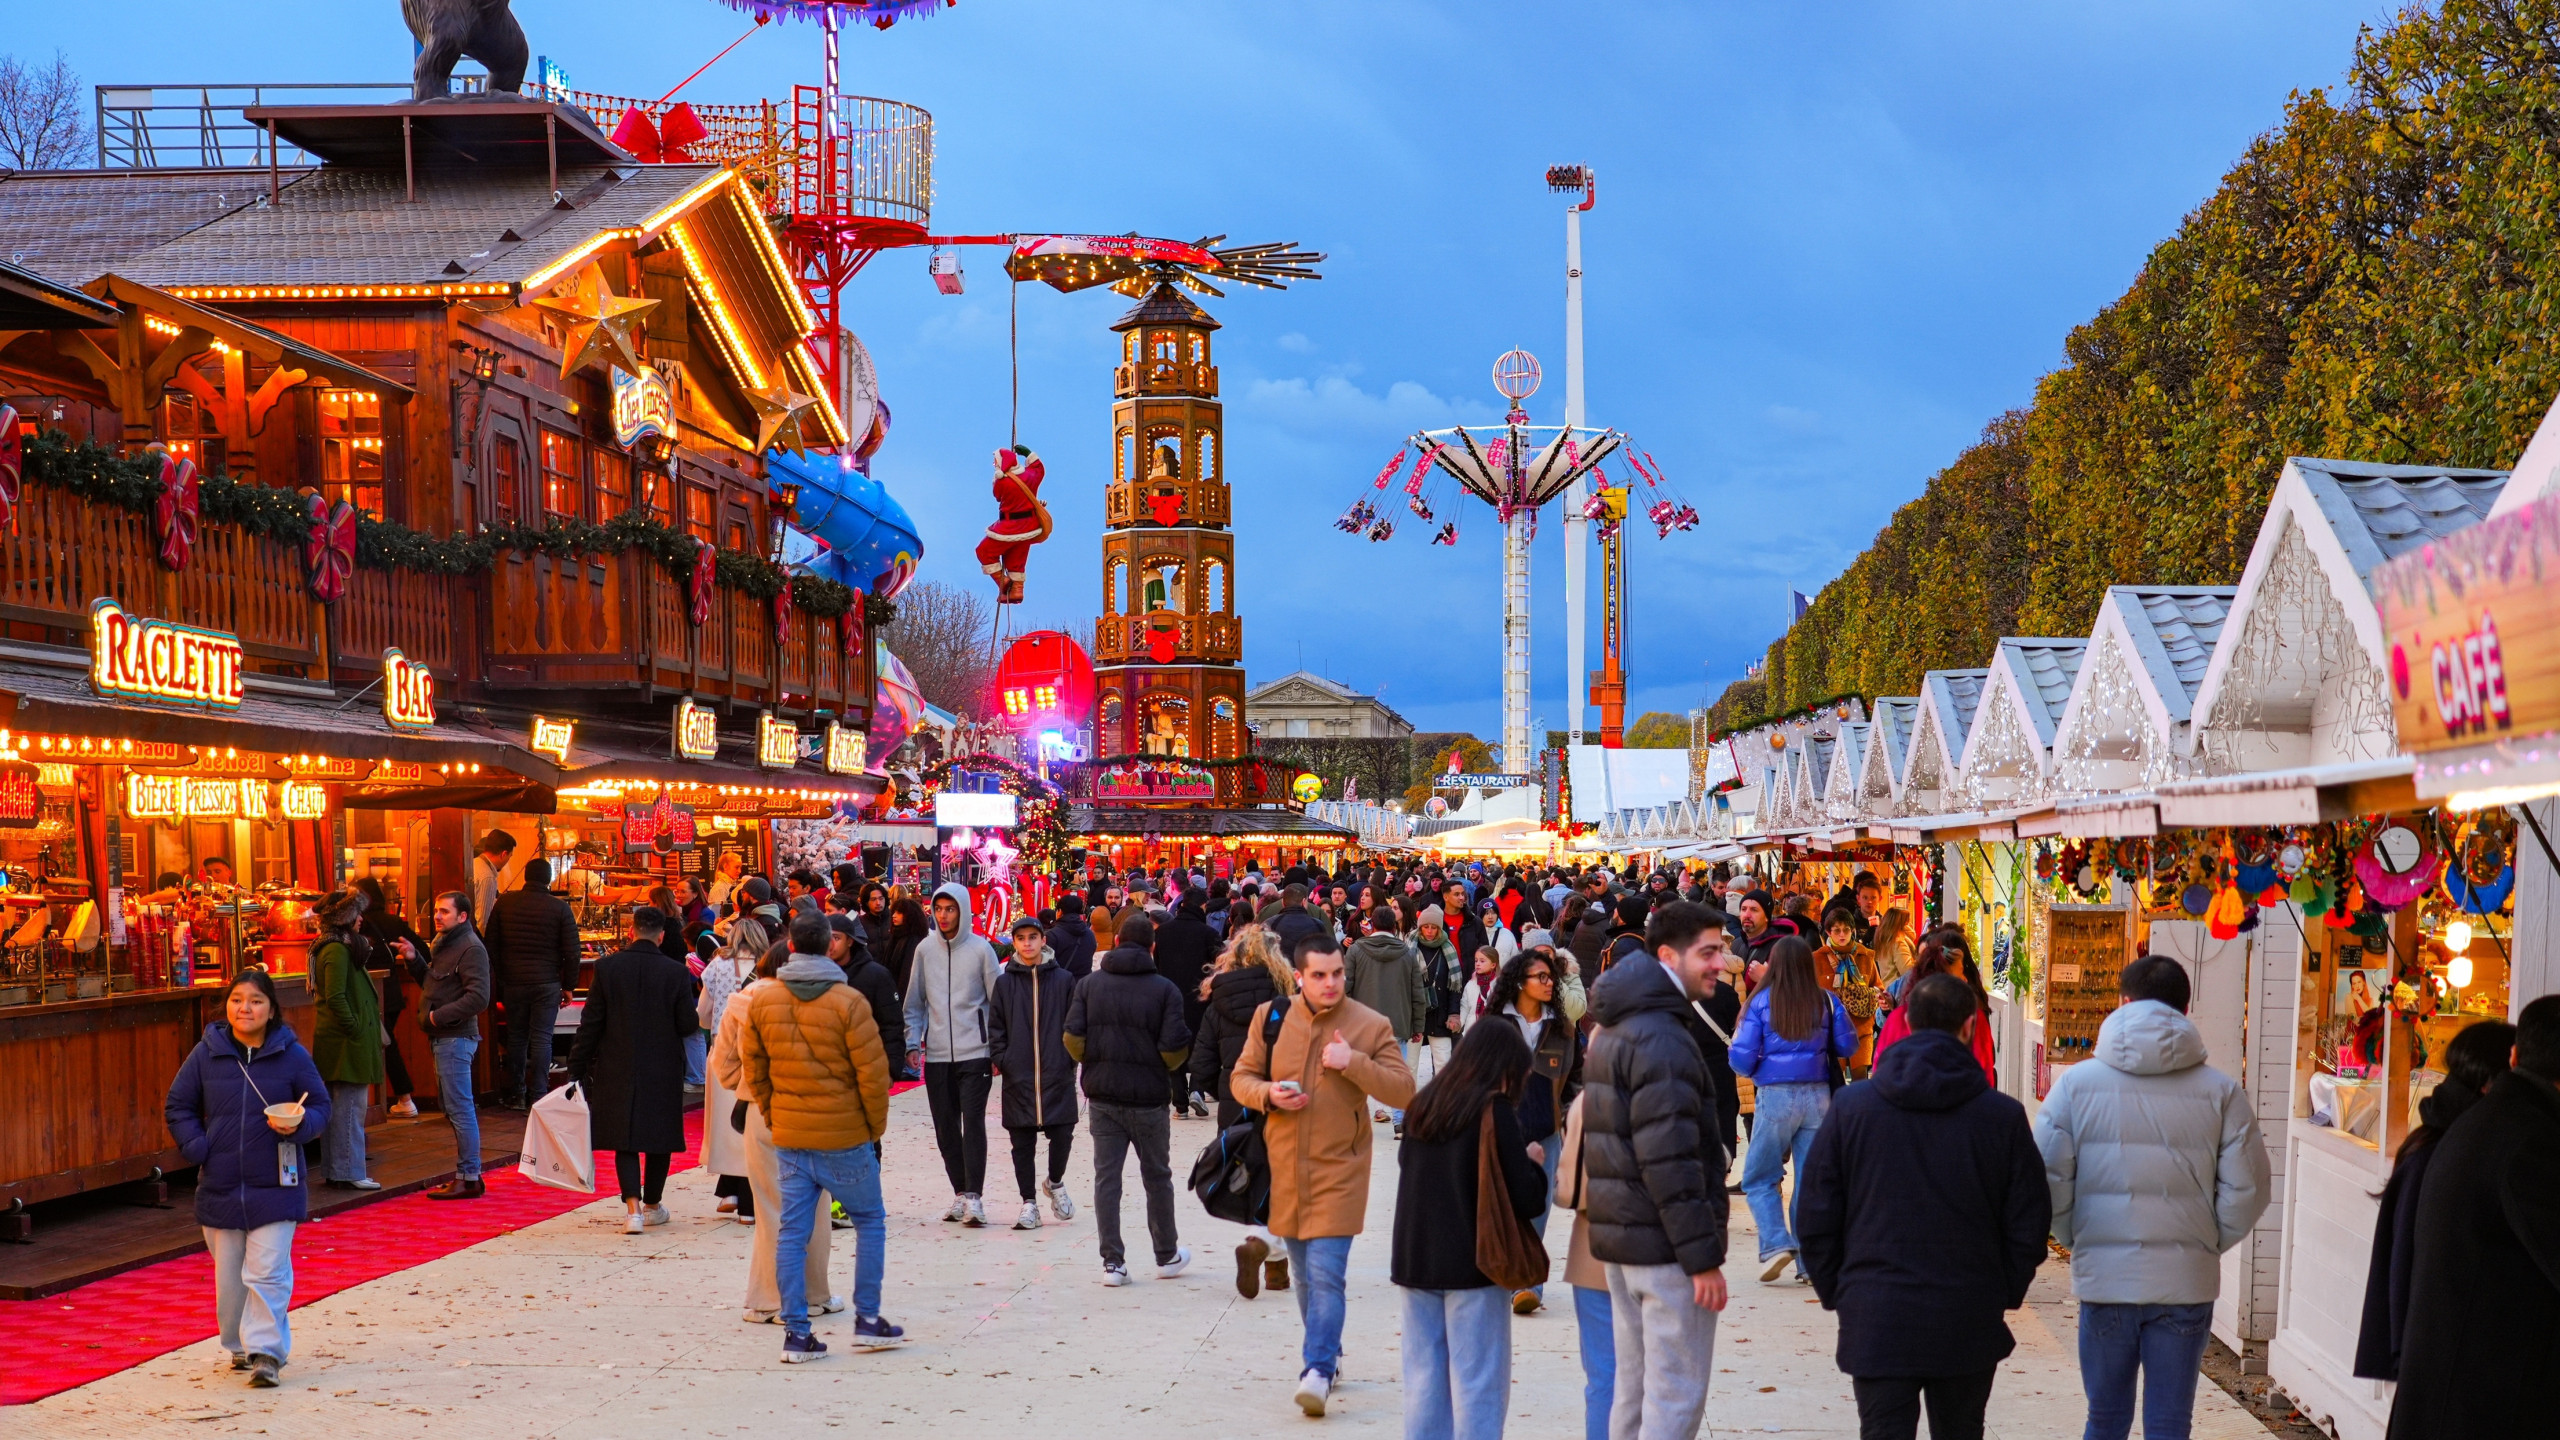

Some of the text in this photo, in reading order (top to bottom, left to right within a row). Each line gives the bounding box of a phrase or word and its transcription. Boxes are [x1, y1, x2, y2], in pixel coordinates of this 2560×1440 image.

[106, 613, 245, 698] RACLETTE
[2431, 610, 2510, 734] CAFÉ
[395, 660, 437, 720] BAR
[687, 706, 719, 752] GRILL
[768, 719, 799, 759] FRITES
[834, 728, 867, 768] BURGER
[224, 754, 266, 773] Noël
[1443, 775, 1521, 786] RESTAURANT
[186, 779, 237, 814] PRESSION
[245, 781, 326, 818] VIN CHAUD
[641, 791, 711, 804] Brwurst
[1101, 782, 1213, 796] LE BAR DE NOËL
